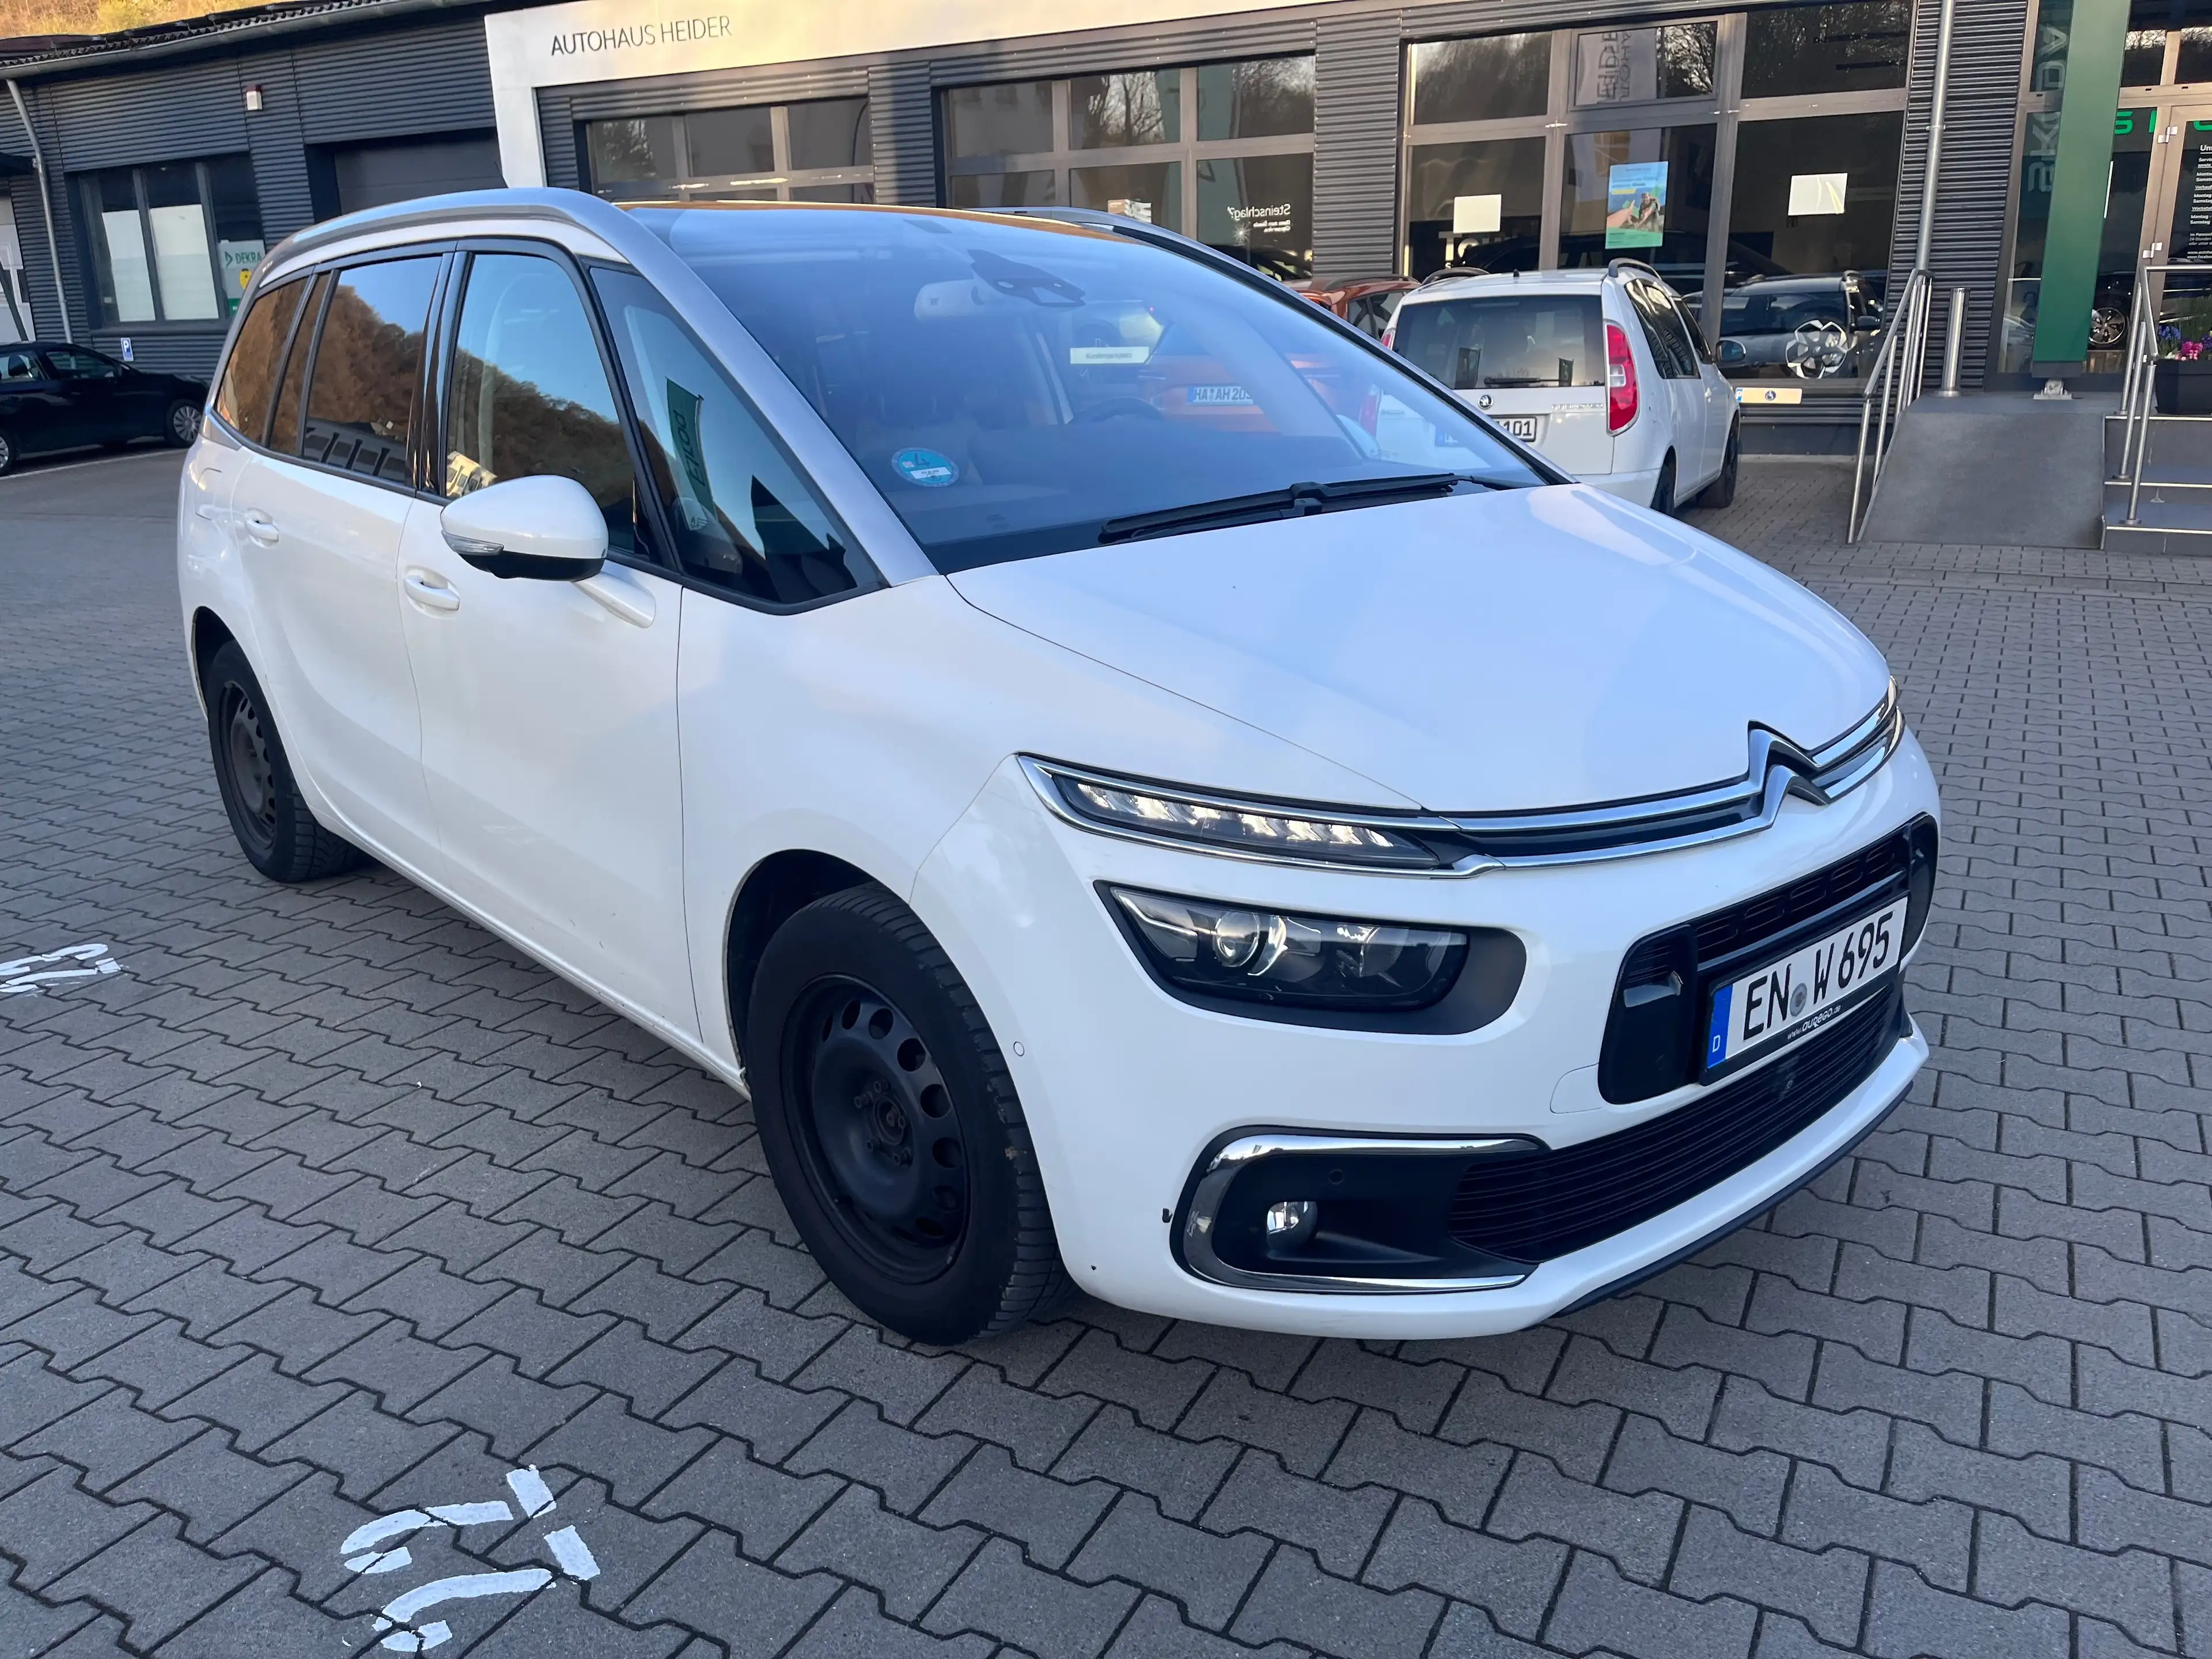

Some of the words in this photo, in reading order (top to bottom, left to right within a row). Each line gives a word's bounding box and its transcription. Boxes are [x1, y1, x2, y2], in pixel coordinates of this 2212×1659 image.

[551, 24, 656, 56] AUTOHAUS
[661, 16, 732, 43] HEIDER
[235, 252, 262, 264] DEKRA
[1497, 421, 1533, 437] 101
[1743, 963, 1791, 1041] EN
[1712, 1034, 1721, 1053] D
